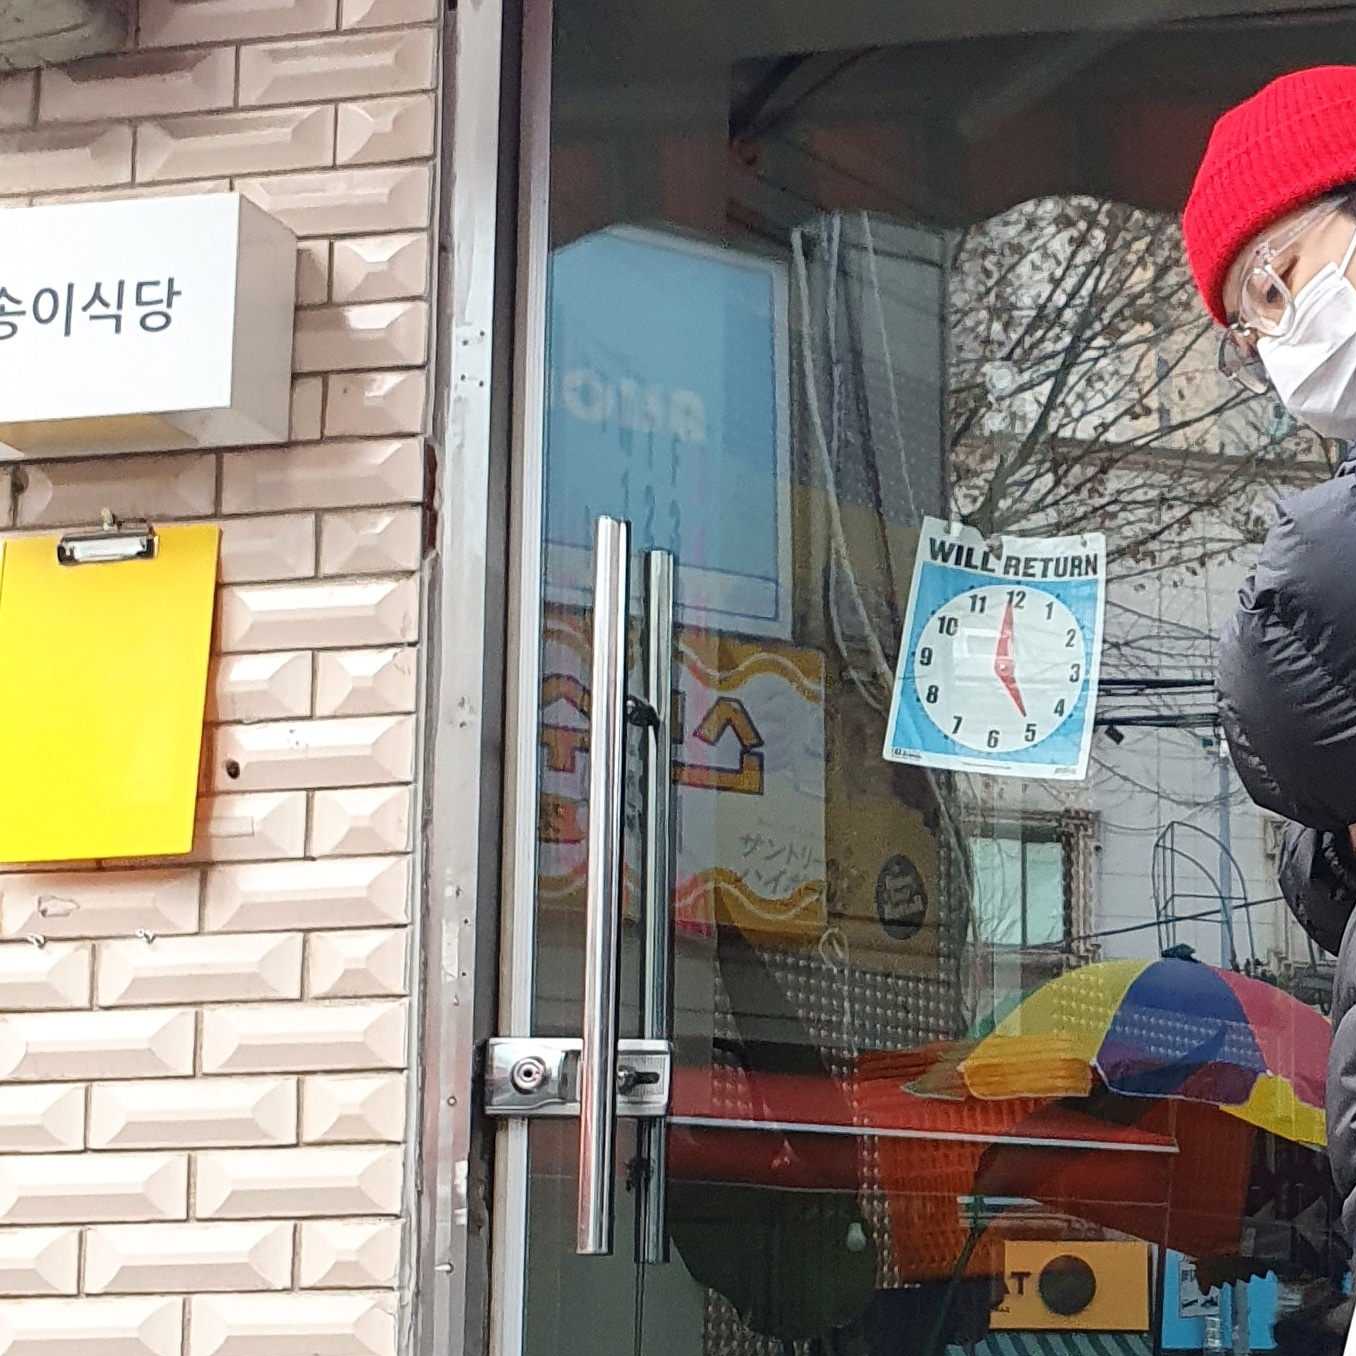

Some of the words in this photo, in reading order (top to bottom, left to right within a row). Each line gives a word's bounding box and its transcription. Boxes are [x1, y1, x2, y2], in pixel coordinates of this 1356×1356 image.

[929, 537, 996, 573] WILL
[1003, 553, 1099, 579] RETURN
[969, 593, 987, 613] 11
[1006, 589, 1027, 609] 12
[1045, 601, 1055, 620] 1
[937, 616, 958, 636] 10
[1065, 628, 1077, 648] 2
[919, 647, 932, 666] 9
[1069, 663, 1081, 683] 3
[926, 685, 938, 704] 8
[1053, 699, 1065, 717] 4
[952, 716, 963, 734] 7
[1024, 723, 1037, 742] 5
[987, 729, 1000, 748] 6
